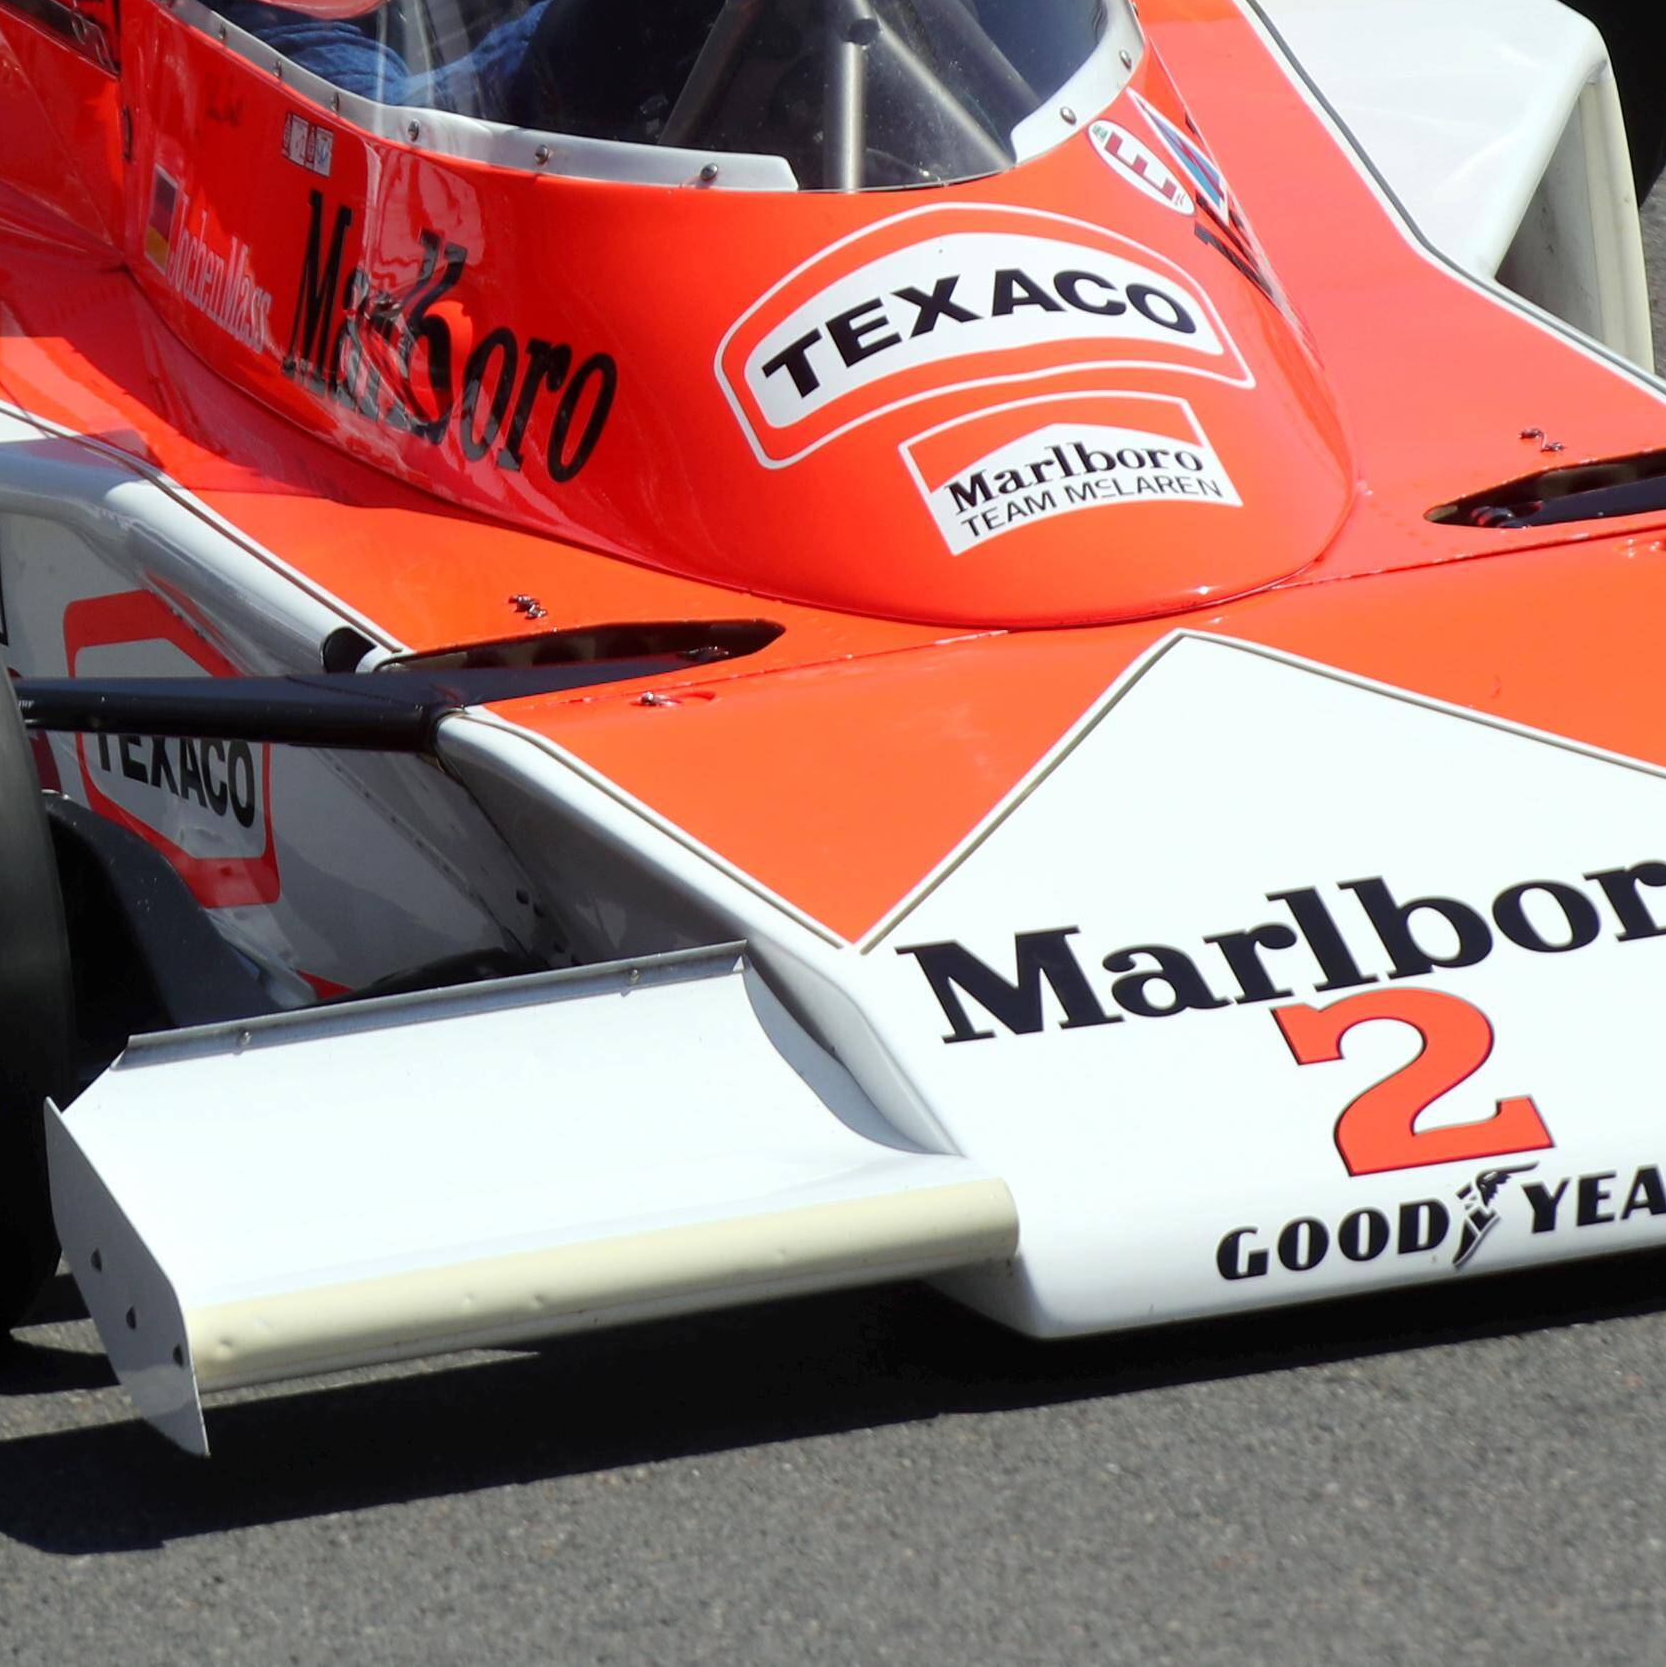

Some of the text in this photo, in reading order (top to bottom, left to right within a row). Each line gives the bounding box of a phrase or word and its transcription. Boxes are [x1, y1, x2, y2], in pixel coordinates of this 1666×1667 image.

[762, 269, 1197, 398] TEXACO
[944, 441, 1205, 516] Marlboro
[960, 489, 1057, 539] TEAM
[1271, 986, 1553, 1177] 2
